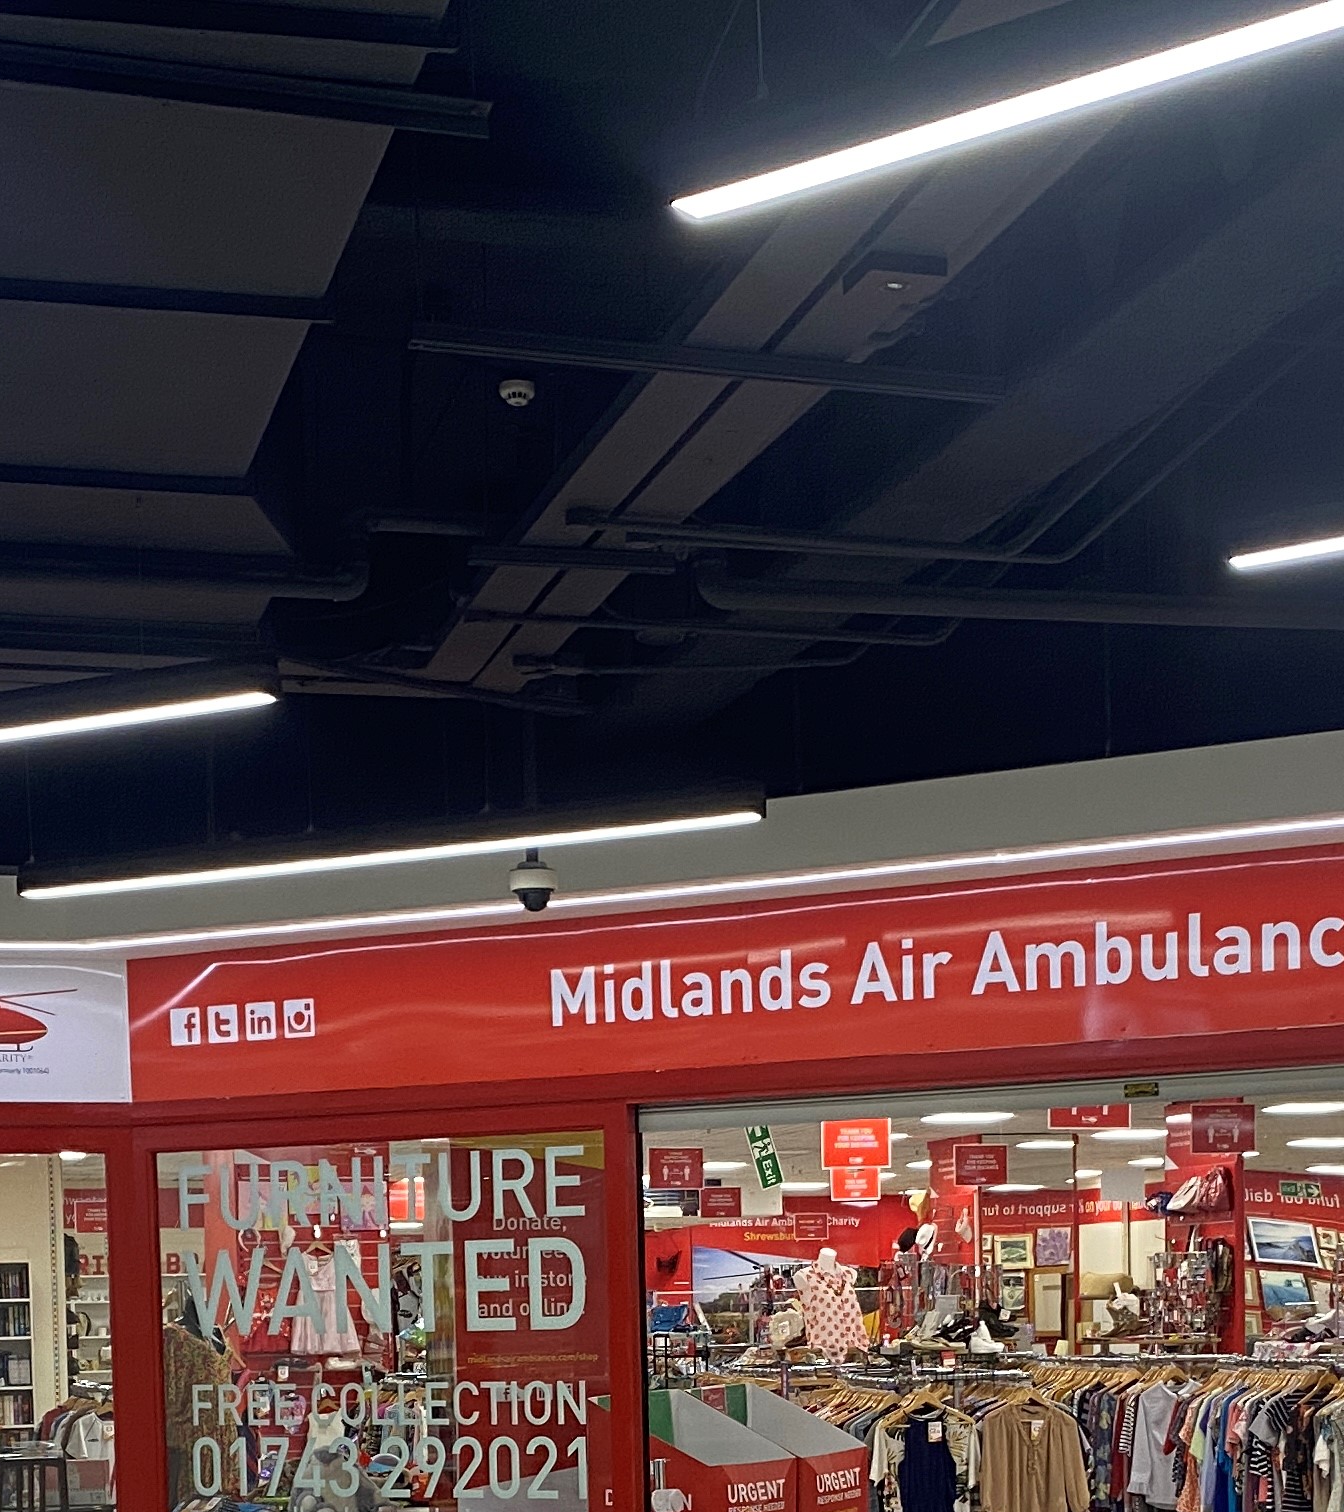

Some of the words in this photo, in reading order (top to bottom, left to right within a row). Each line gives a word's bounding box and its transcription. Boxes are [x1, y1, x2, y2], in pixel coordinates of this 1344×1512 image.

[549, 948, 831, 1029] Midlands
[851, 938, 952, 1007] Air
[762, 1160, 777, 1186] Exit
[178, 1146, 586, 1232] FURNITURE
[493, 1214, 567, 1232] Donate,
[754, 1217, 770, 1227] Air
[185, 1237, 587, 1338] WANTED
[479, 1299, 513, 1317] and
[192, 1382, 298, 1427] FREE
[312, 1379, 588, 1427] COLLECTION
[192, 1436, 360, 1498] 01743
[381, 1436, 588, 1500] 292021
[816, 1467, 861, 1493] URGENT
[727, 1478, 786, 1503] URGENT
